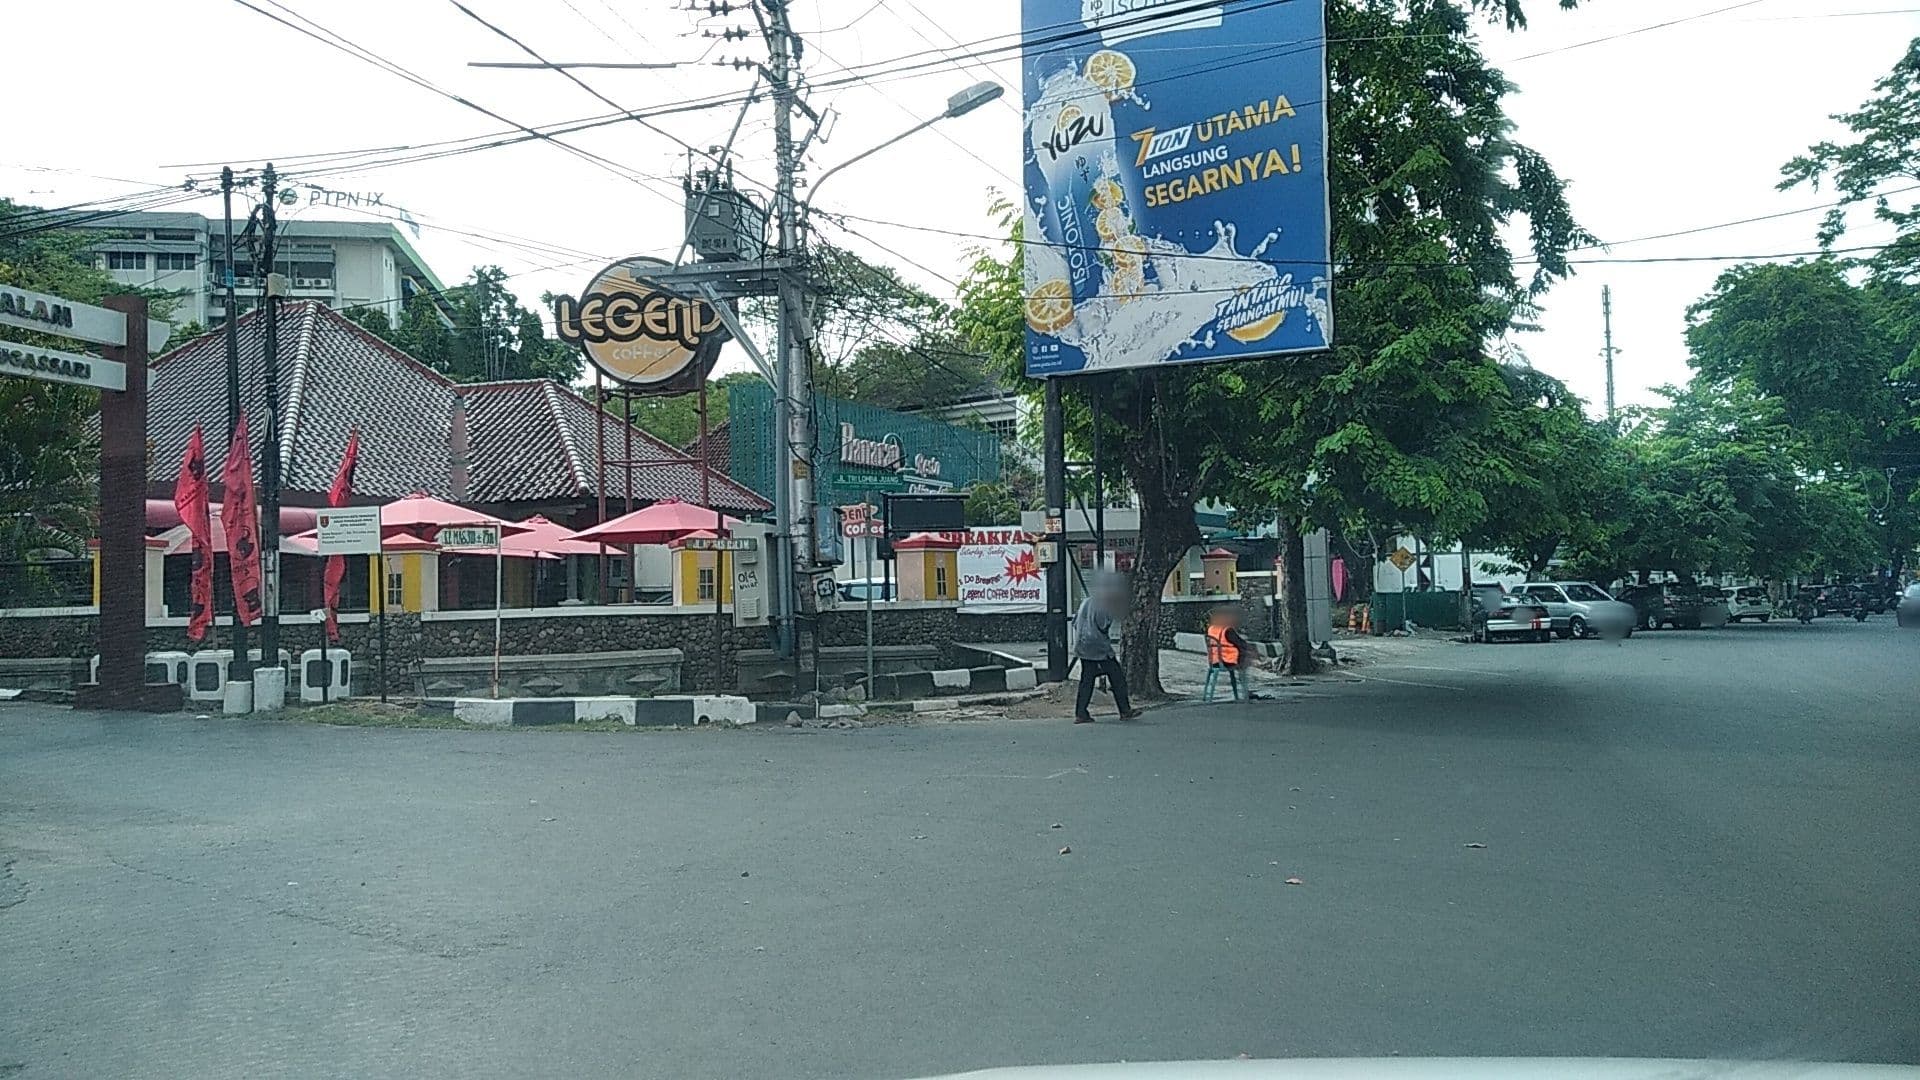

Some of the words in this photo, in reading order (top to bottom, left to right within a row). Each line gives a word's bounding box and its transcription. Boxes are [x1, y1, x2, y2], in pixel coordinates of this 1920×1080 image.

[1041, 112, 1104, 160] YUZU
[1196, 94, 1297, 142] UTAMA
[1143, 145, 1228, 179] LANGSUNG
[1145, 144, 1302, 207] SEGARNYA!
[309, 190, 360, 207] PTPN
[366, 191, 384, 206] IX
[1058, 196, 1086, 286] ISOTONIC
[1216, 286, 1305, 333] SEMANGATMU!
[1217, 273, 1292, 318] TANTANG
[561, 297, 722, 345] LEGEND
[858, 475, 877, 483] LOMBA
[962, 589, 985, 600] Legend
[987, 589, 1008, 600] Coffee
[964, 575, 974, 583] Do
